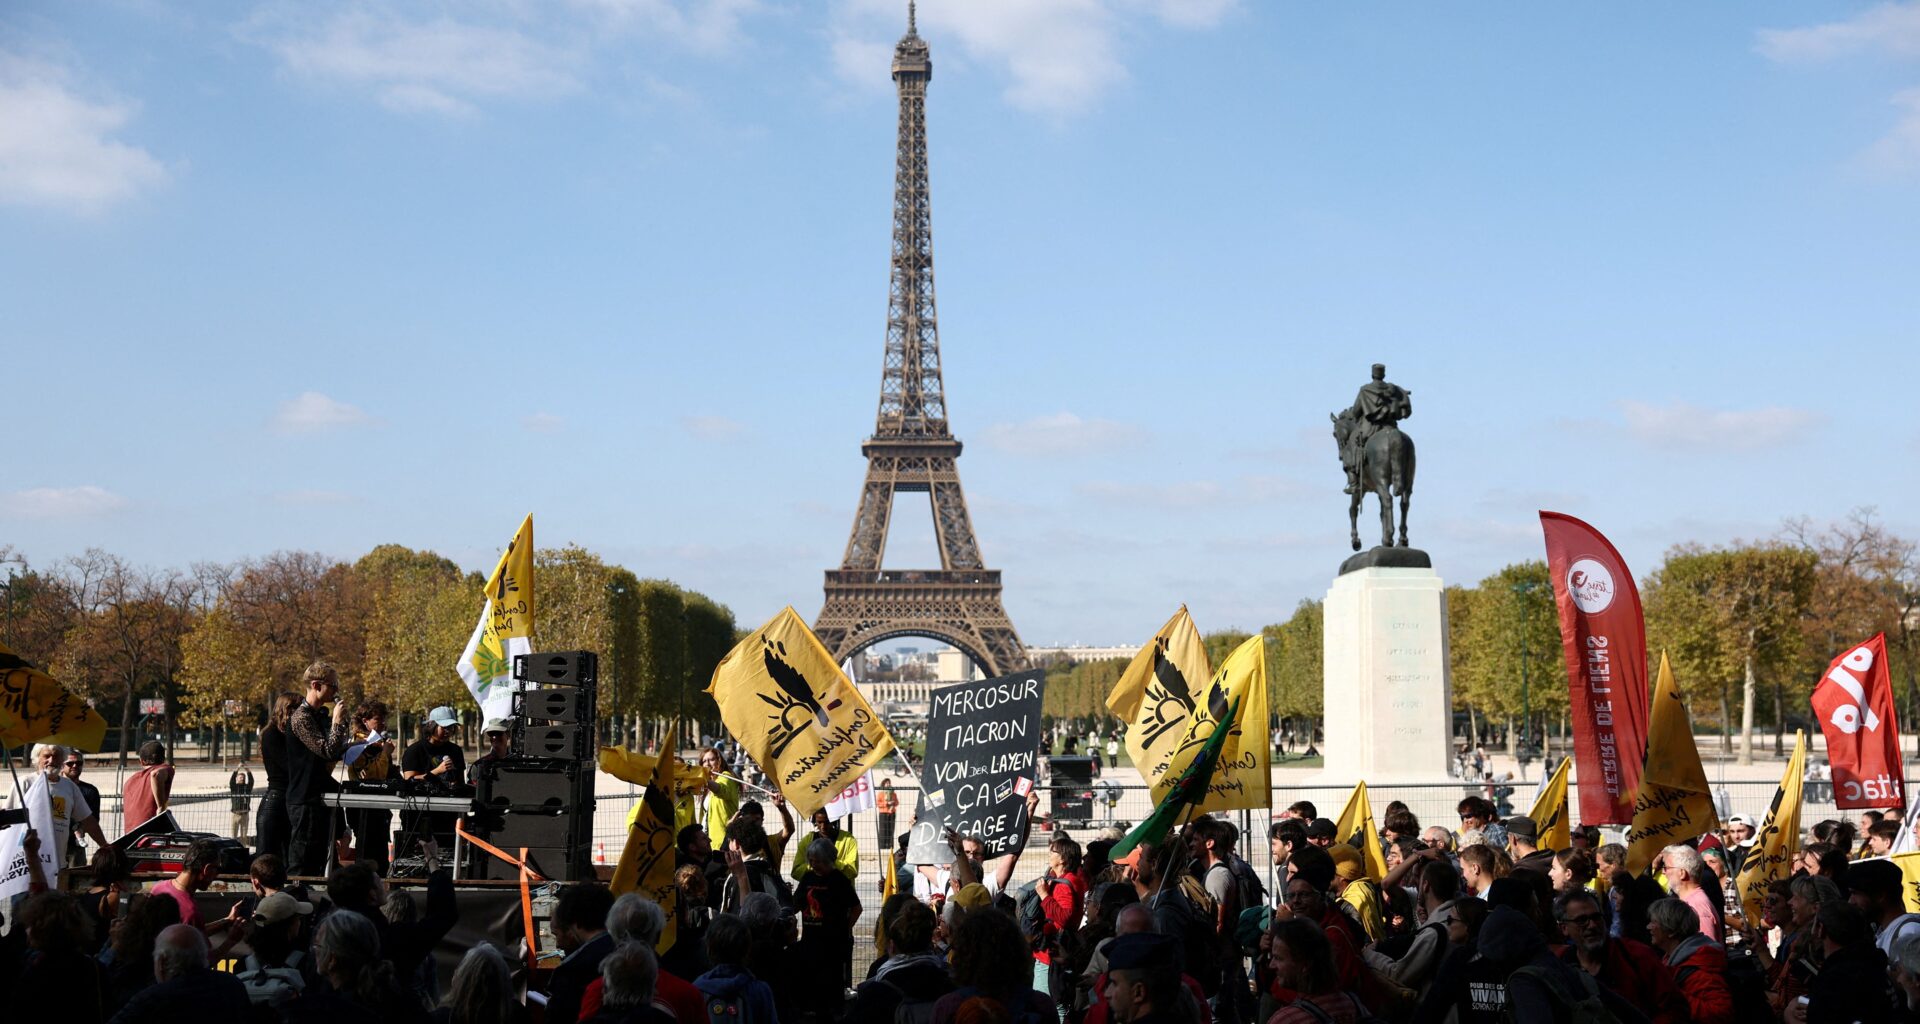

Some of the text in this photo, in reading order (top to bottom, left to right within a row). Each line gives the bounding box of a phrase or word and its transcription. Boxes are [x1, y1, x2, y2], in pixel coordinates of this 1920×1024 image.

[933, 679, 1038, 718] MERCOSUR
[944, 715, 1027, 750] MACRON
[934, 750, 1033, 784] VON DER LAYEN
[956, 783, 990, 815] ÇA
[915, 814, 1007, 846] DÉGAGE
[984, 835, 1007, 854] ITE
[1470, 989, 1505, 1004] VIVAN
